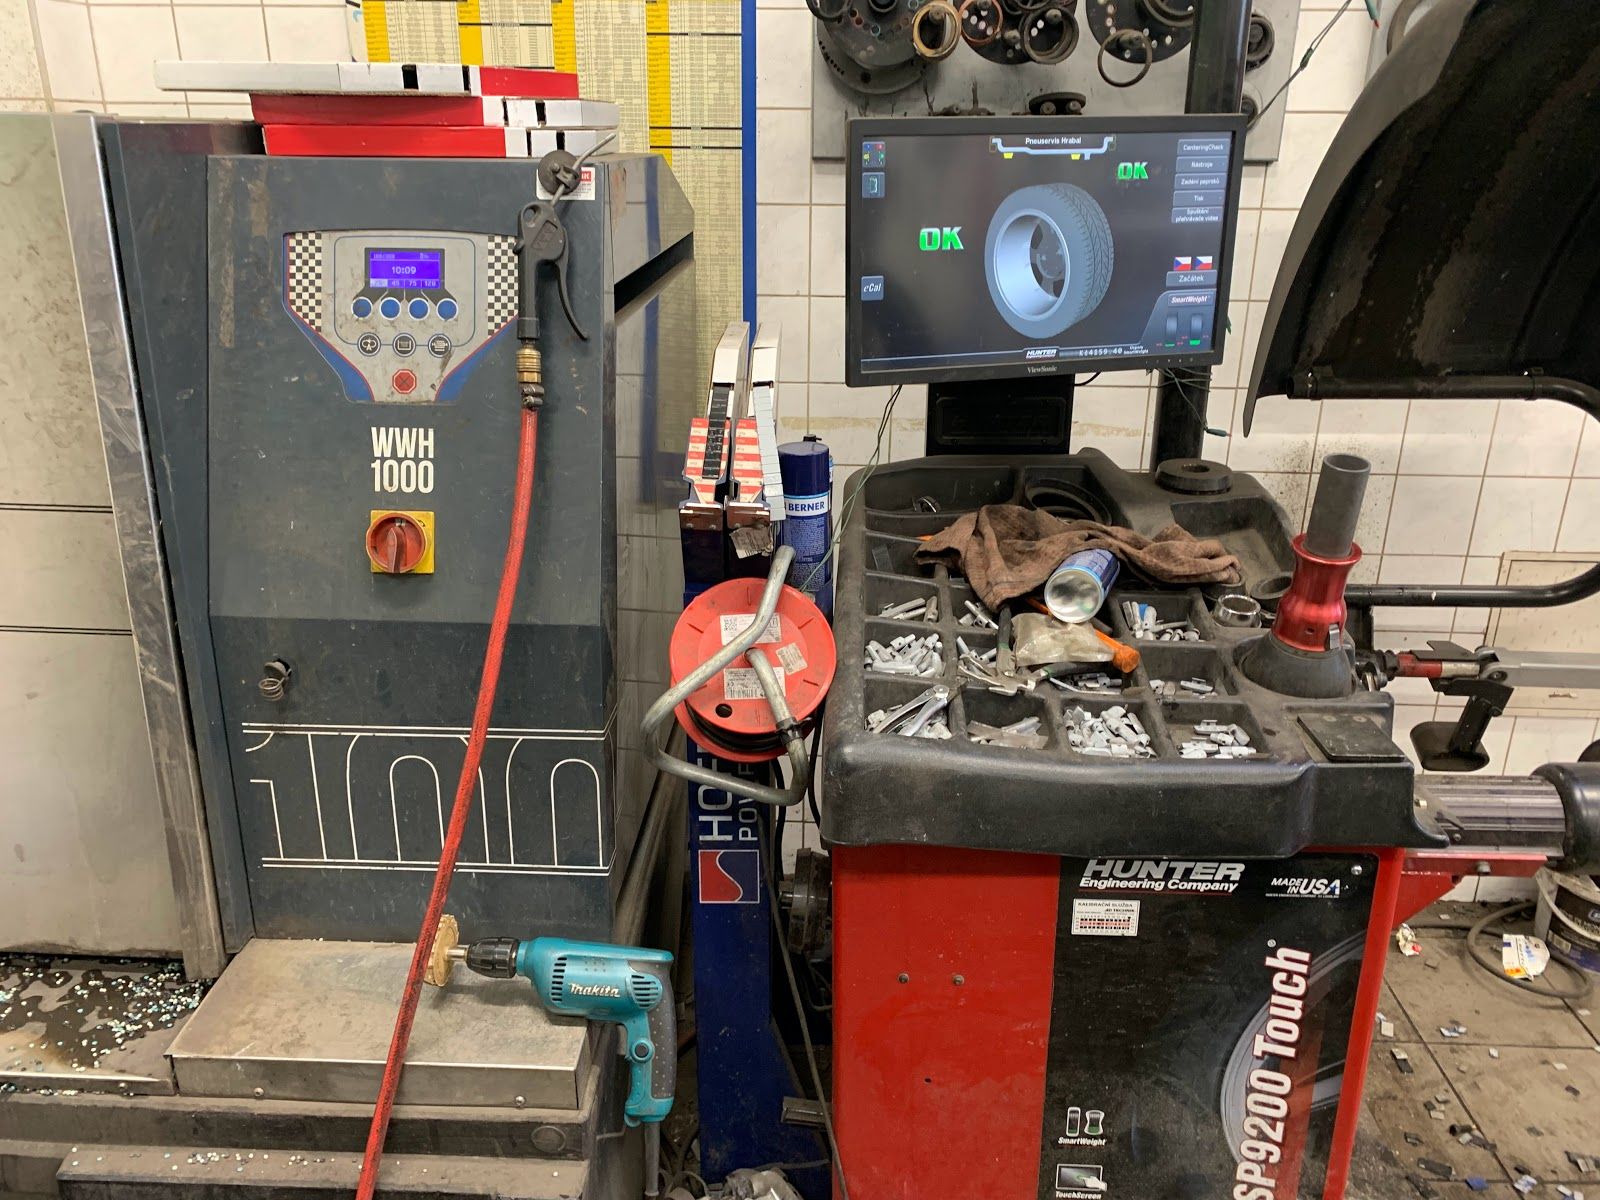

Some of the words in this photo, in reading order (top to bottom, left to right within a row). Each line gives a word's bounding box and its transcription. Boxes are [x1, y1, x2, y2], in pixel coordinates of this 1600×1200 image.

[1025, 137, 1060, 145] Pneuservis
[1117, 161, 1149, 180] OK
[919, 226, 965, 251] OK
[391, 266, 417, 275] 10:09
[863, 282, 882, 292] eCal
[1171, 295, 1208, 304] SmartWeight
[1027, 365, 1058, 374] ViewSonic
[371, 427, 434, 458] WWH
[371, 459, 434, 494] 1000
[788, 501, 825, 512] BERNER
[1082, 859, 1246, 881] HUNTER
[1079, 877, 1165, 891] Engineering
[1167, 878, 1239, 892] Company
[1270, 877, 1303, 886] MADE
[1299, 878, 1341, 895] USA
[1287, 886, 1300, 894] IN
[1253, 946, 1312, 1059] Touch
[1232, 1068, 1292, 1200] SP9200
[1057, 1136, 1107, 1147] SmartWeight
[1055, 1190, 1102, 1199] TouchScreen
